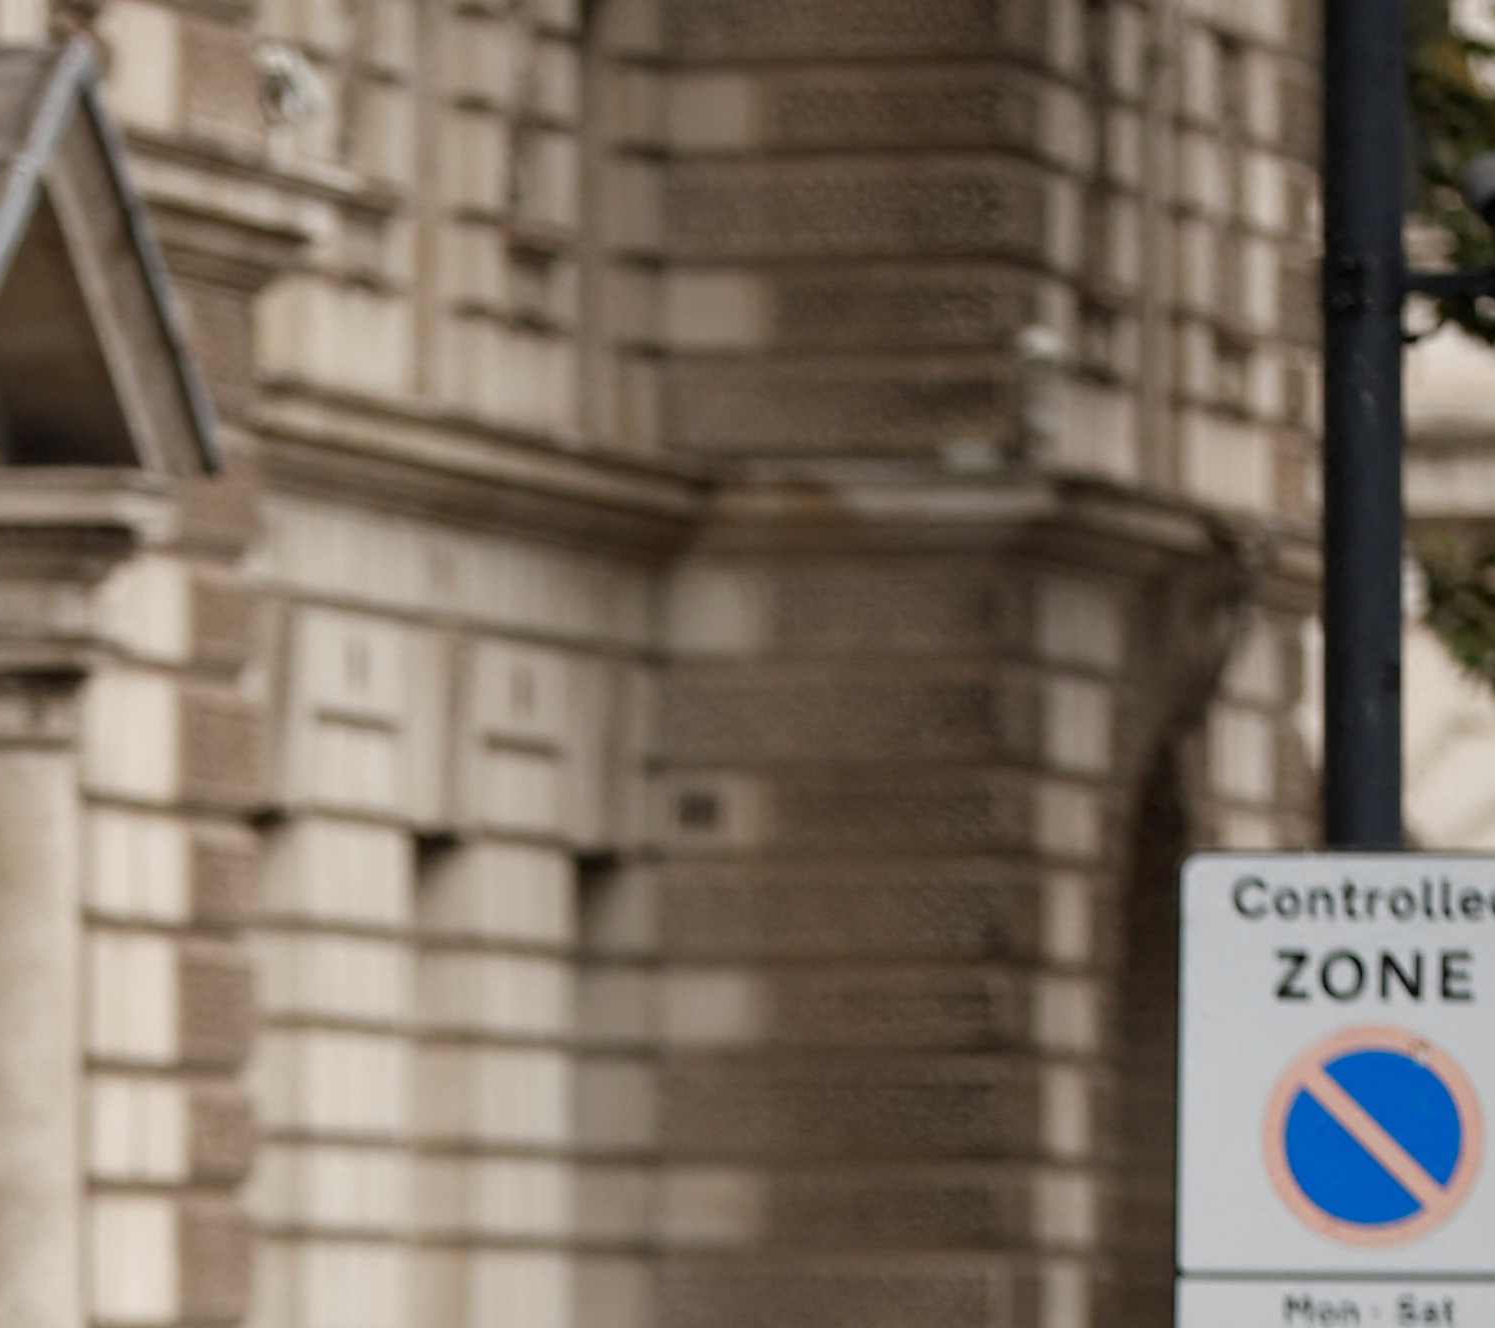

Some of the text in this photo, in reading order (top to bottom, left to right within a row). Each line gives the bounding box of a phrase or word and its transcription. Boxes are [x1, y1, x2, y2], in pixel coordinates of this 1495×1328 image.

[1274, 950, 1476, 1001] ZONE
[1283, 1294, 1455, 1326] Mon Sat
